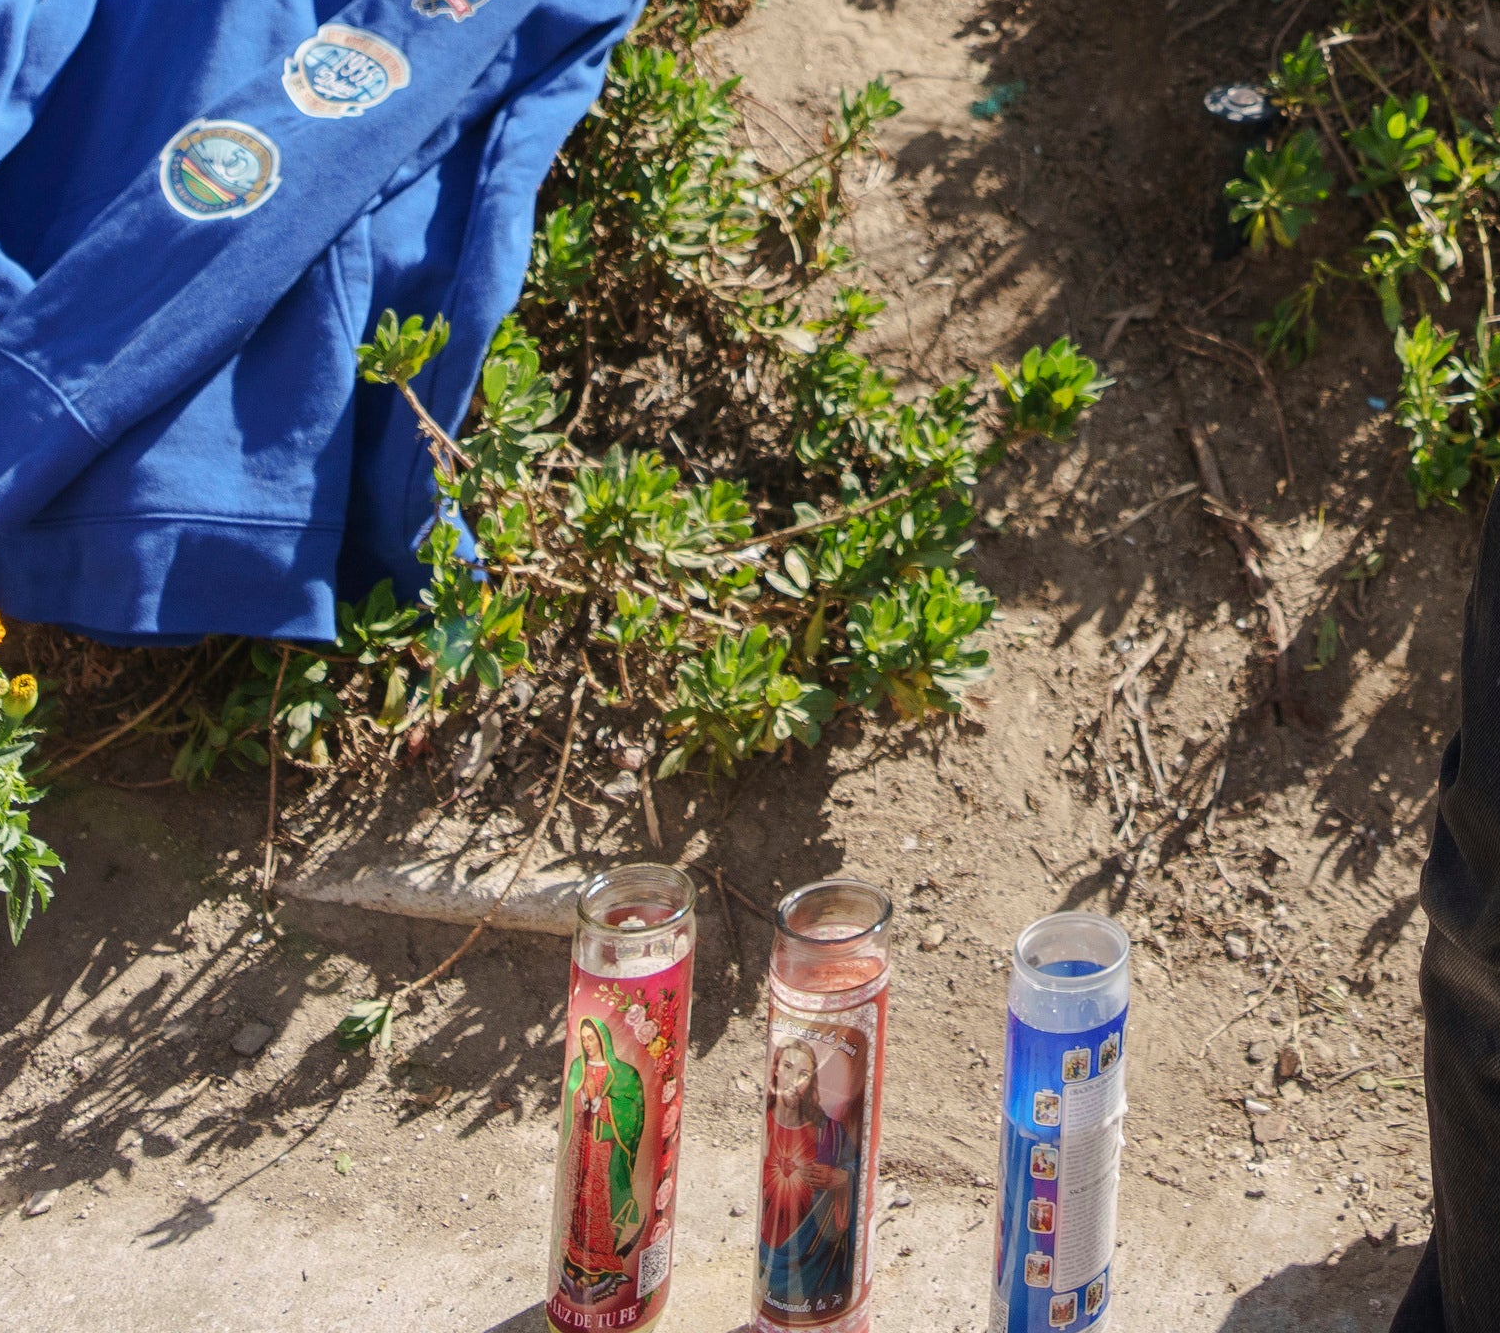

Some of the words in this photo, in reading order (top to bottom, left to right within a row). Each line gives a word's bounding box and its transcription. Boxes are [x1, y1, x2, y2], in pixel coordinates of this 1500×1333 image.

[552, 1299, 571, 1324] LUZ
[574, 1313, 592, 1329] DE
[596, 1311, 617, 1329] TU
[619, 1305, 638, 1325] FE
